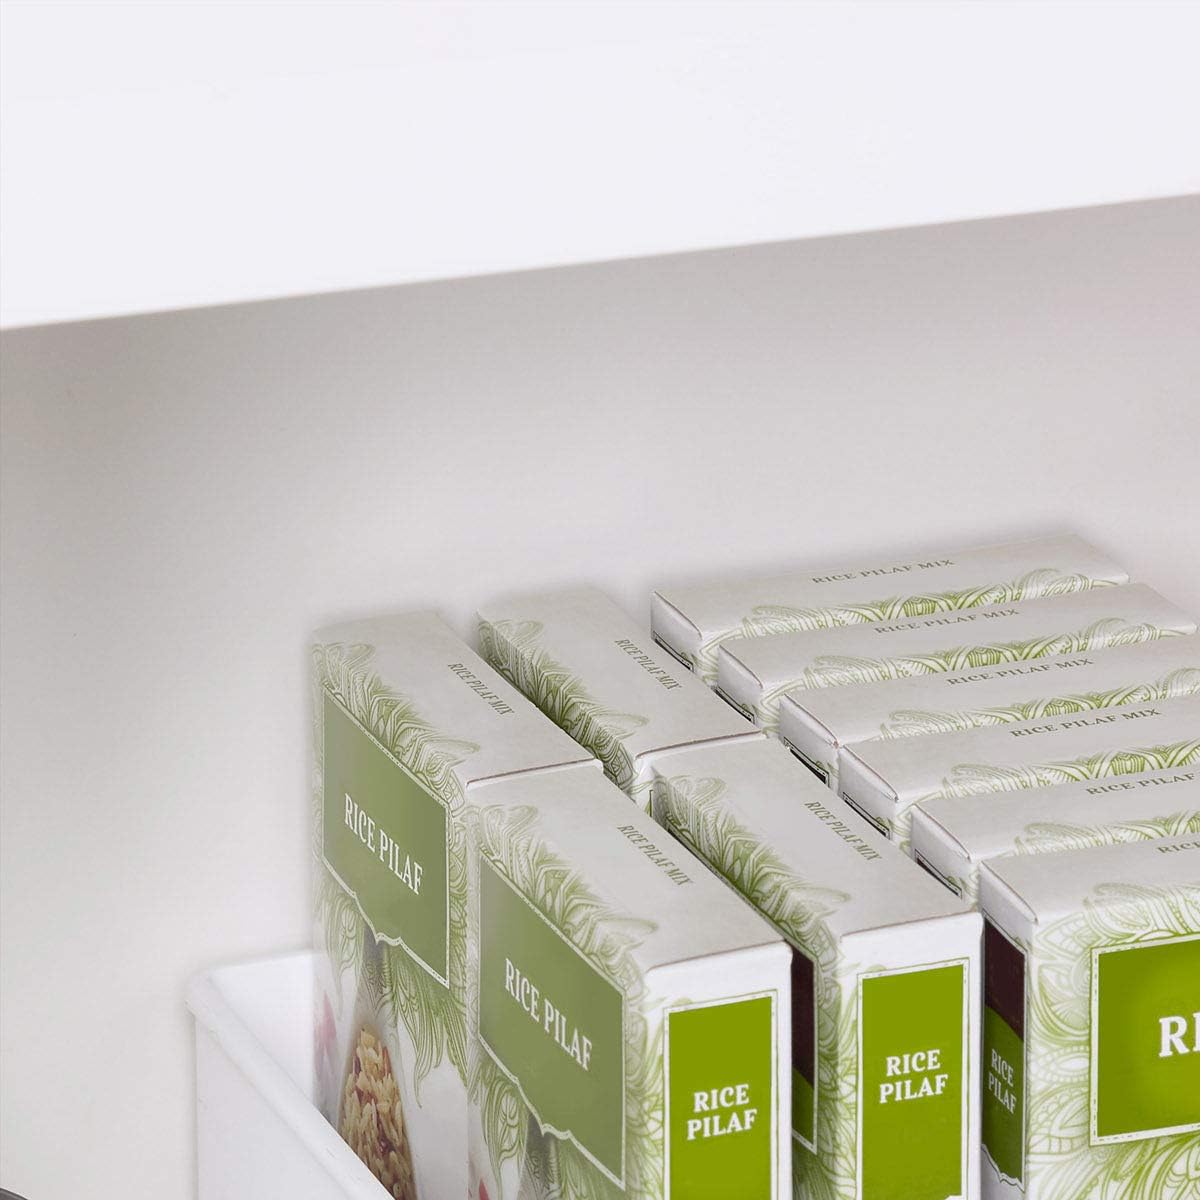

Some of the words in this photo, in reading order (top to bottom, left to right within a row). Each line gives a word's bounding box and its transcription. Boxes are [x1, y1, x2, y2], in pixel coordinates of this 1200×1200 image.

[812, 573, 854, 584] RICE
[860, 565, 912, 578] PILAF
[917, 559, 956, 569] MIX
[874, 622, 920, 634] RICE
[924, 614, 977, 627] PILAF
[982, 608, 1021, 618] MIX
[614, 640, 641, 656] RICE
[634, 654, 666, 677] PILAF
[656, 675, 682, 690] MIX
[948, 672, 994, 685] RICE
[998, 663, 1050, 678] PILAF
[1055, 657, 1095, 669] MIX
[448, 663, 475, 682] RICE
[467, 680, 496, 702] PILAF
[489, 698, 514, 715] MIX
[1010, 724, 1057, 737] RICE
[1061, 715, 1116, 731] PILAF
[1122, 707, 1162, 720] MIX
[1087, 782, 1135, 795] RICE
[1139, 773, 1195, 788] PILAF
[344, 793, 375, 852] RICE
[380, 830, 423, 895] PILAF
[804, 802, 835, 823] RICE
[828, 821, 862, 848] PILAF
[853, 844, 882, 861] MIX
[617, 825, 647, 845] RICE
[640, 844, 674, 869] PILAF
[665, 867, 694, 886] MIX
[506, 958, 539, 1022] RICE
[544, 999, 592, 1071] PILAF
[886, 1049, 941, 1077] RICE
[992, 1048, 1014, 1087] RICE
[694, 1083, 749, 1113] RICE
[879, 1074, 948, 1104] PILAF
[988, 1072, 1016, 1114] PILAF
[687, 1108, 757, 1141] PILAF
